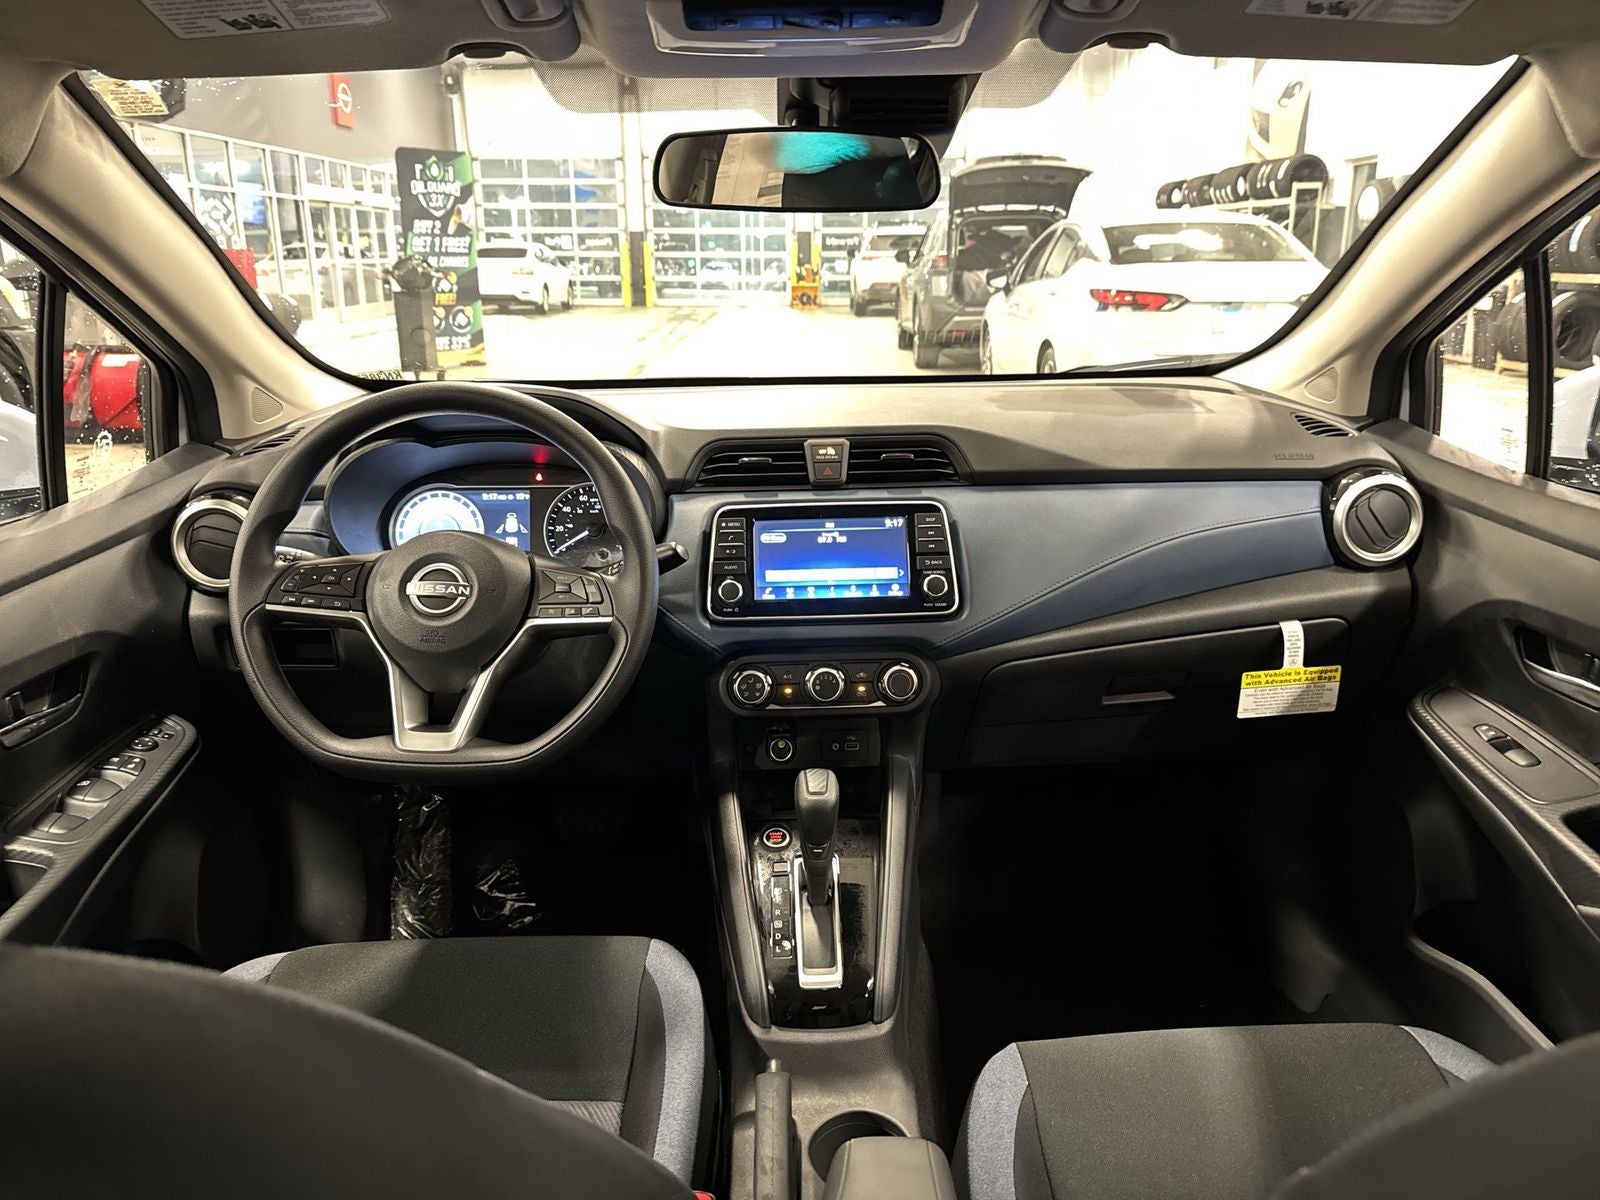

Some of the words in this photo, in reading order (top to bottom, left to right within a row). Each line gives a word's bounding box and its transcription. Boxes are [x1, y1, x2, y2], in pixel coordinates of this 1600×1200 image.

[412, 235, 432, 253] GET
[1263, 671, 1292, 679] Vehicle
[1303, 667, 1339, 676] Equipped
[1264, 676, 1302, 685] Advanced
[1317, 674, 1337, 682] Bags
